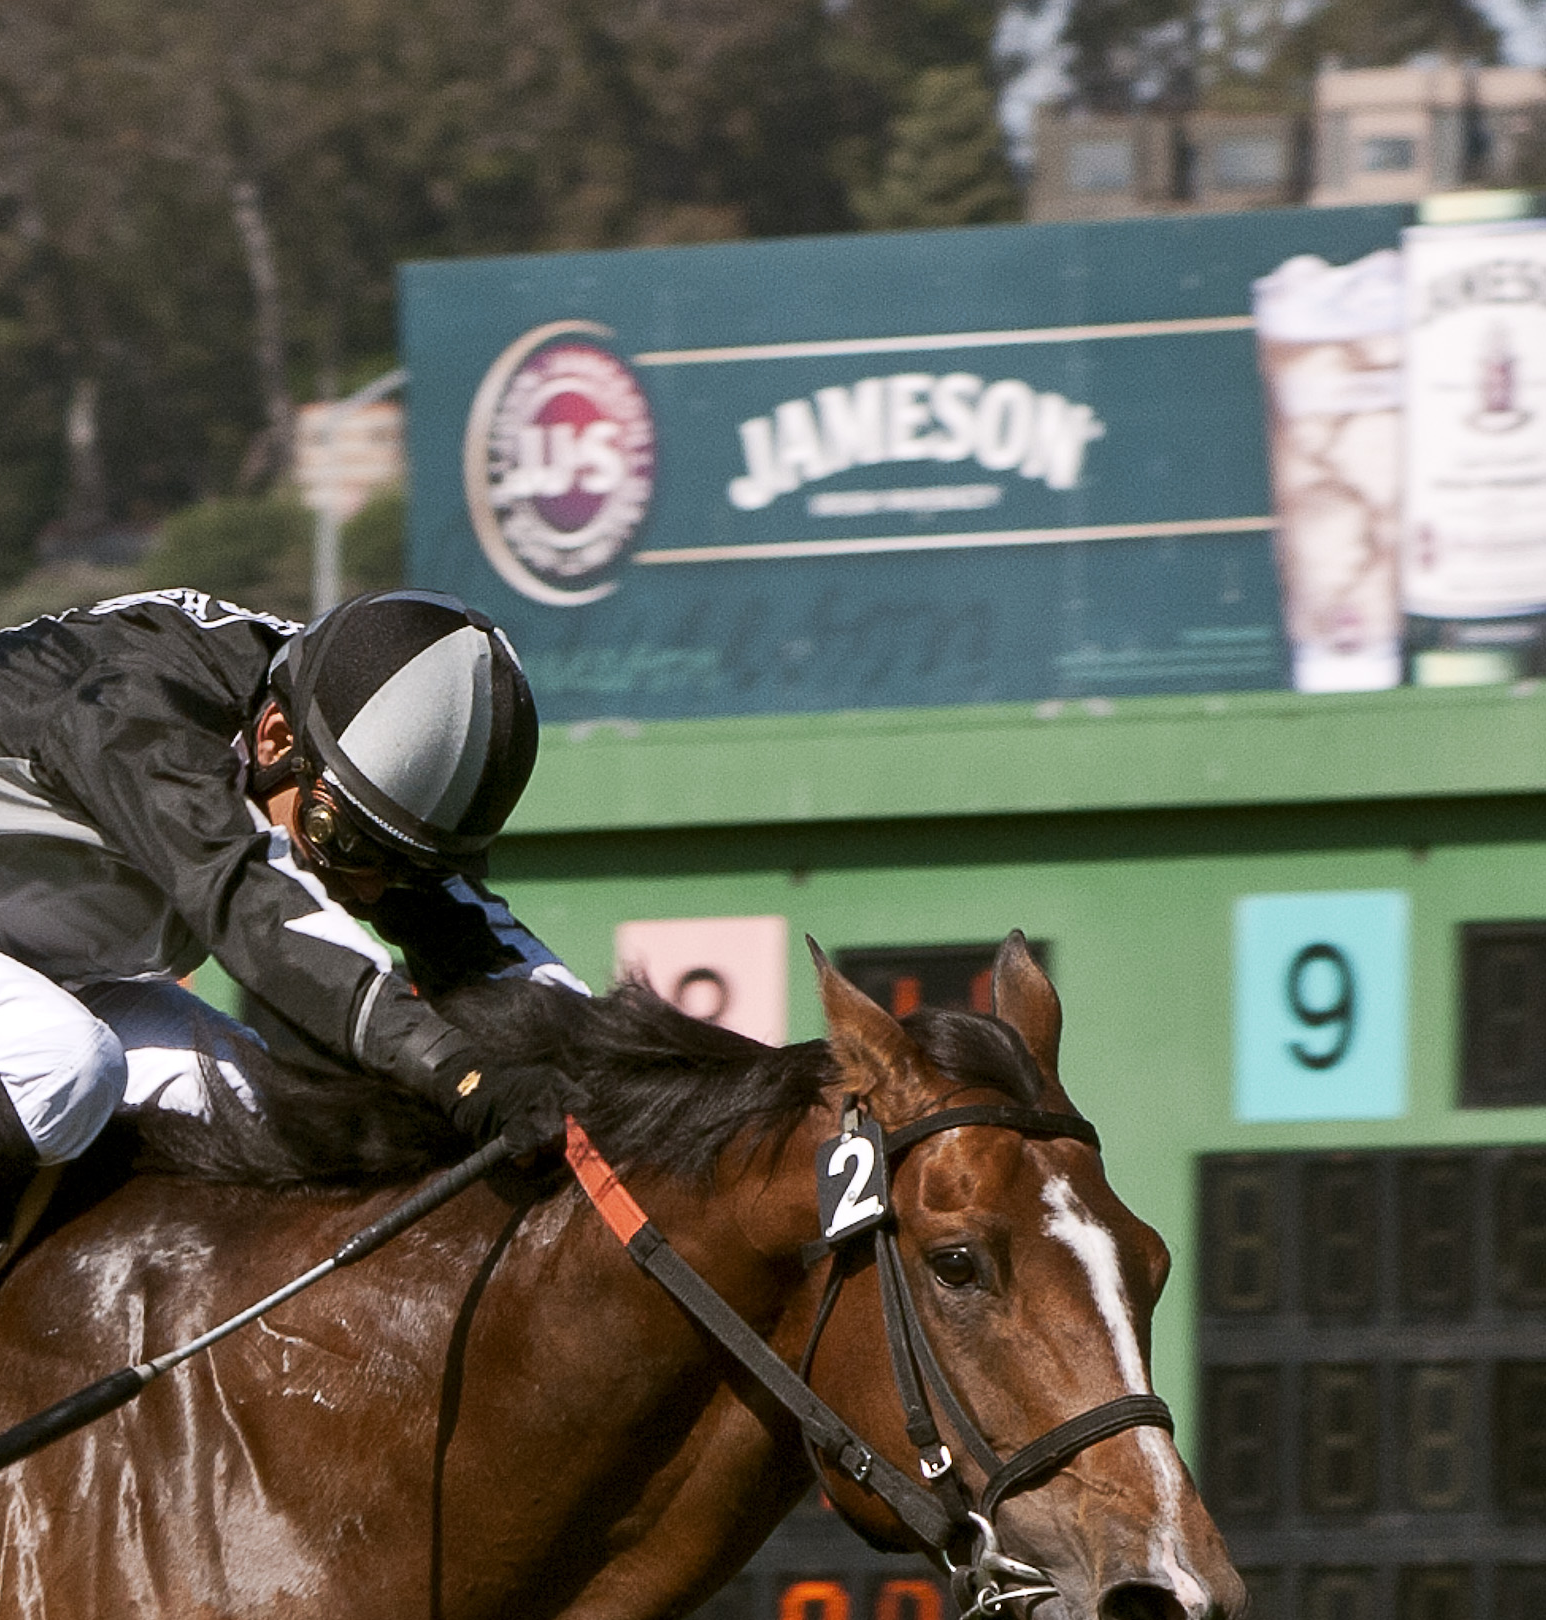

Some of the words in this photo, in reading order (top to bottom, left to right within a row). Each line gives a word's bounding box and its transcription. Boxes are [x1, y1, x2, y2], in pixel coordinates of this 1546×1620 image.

[727, 372, 1104, 512] JAMESON
[1288, 940, 1357, 1072] 9
[825, 1134, 886, 1238] 2
